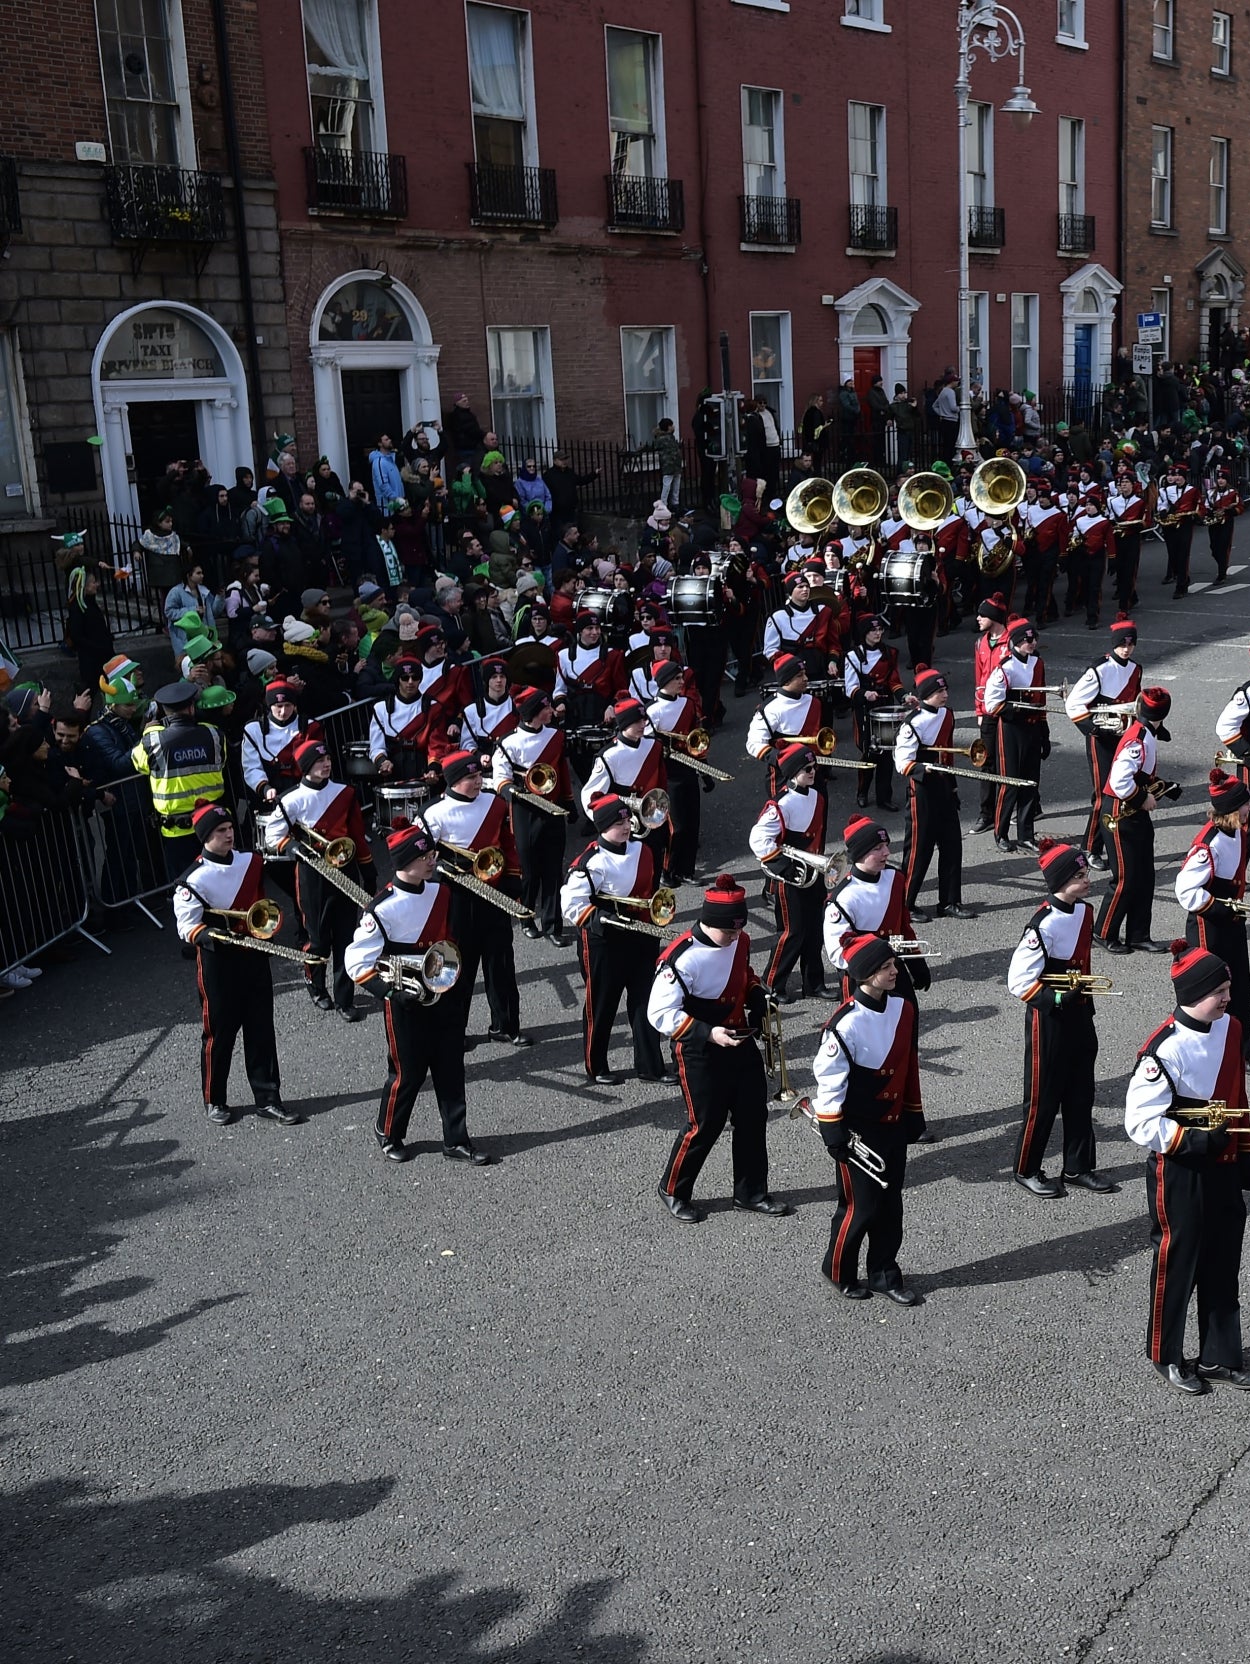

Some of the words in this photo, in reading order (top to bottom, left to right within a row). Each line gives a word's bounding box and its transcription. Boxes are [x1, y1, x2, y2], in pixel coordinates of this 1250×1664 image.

[351, 309, 368, 322] 29
[140, 343, 172, 356] TAXI
[173, 748, 208, 762] GARDA
